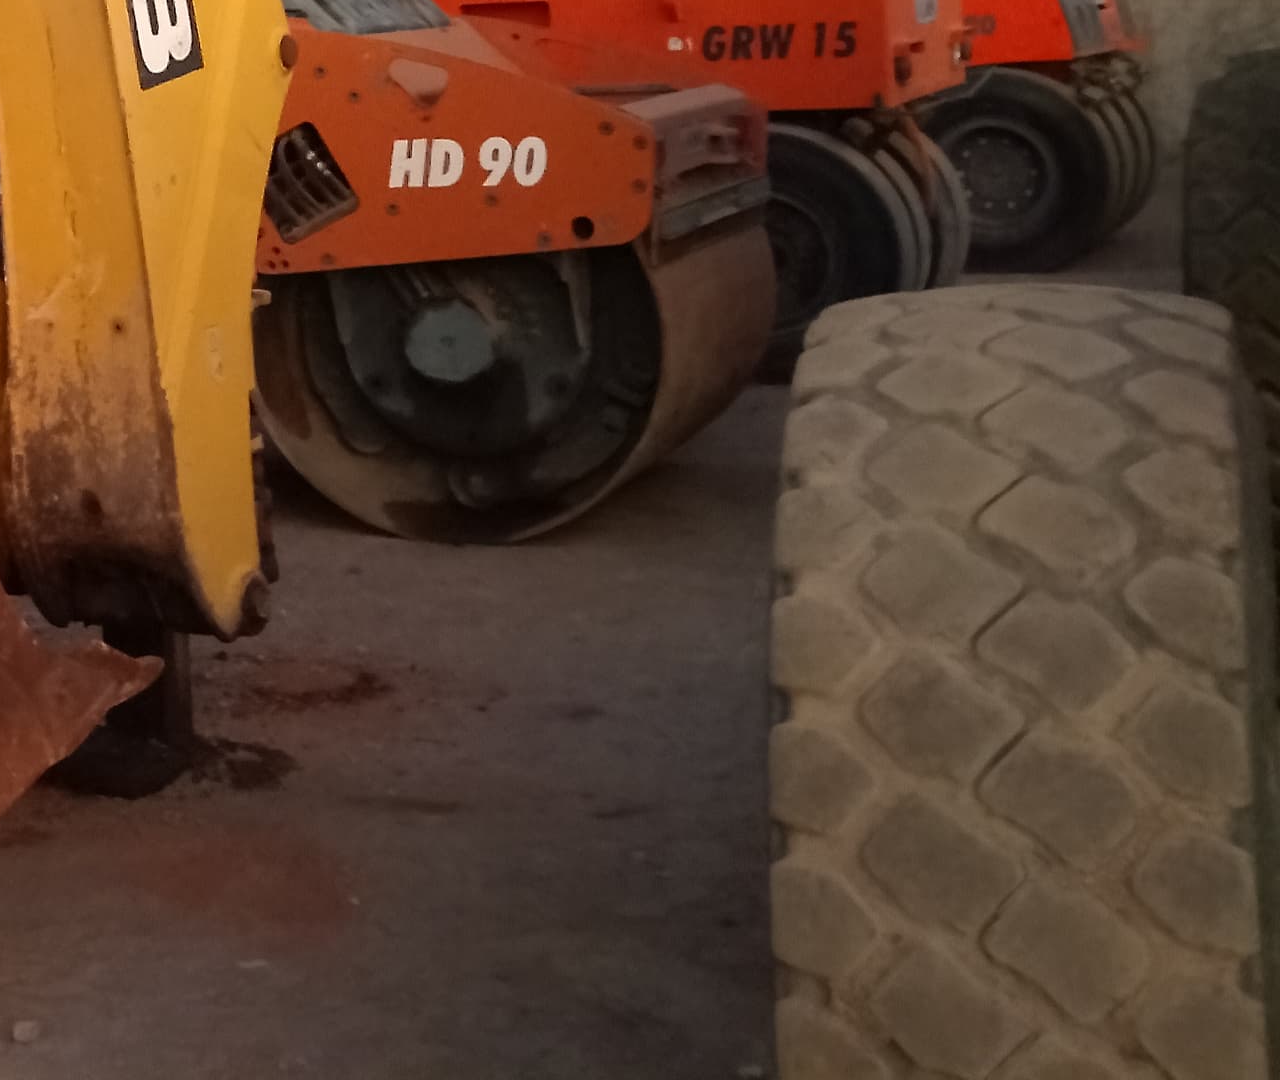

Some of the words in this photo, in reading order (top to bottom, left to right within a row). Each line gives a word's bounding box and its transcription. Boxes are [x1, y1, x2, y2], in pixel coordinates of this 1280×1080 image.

[701, 24, 795, 62] GRW
[813, 21, 857, 58] 15
[389, 138, 464, 188] HD
[479, 136, 548, 187] 90
